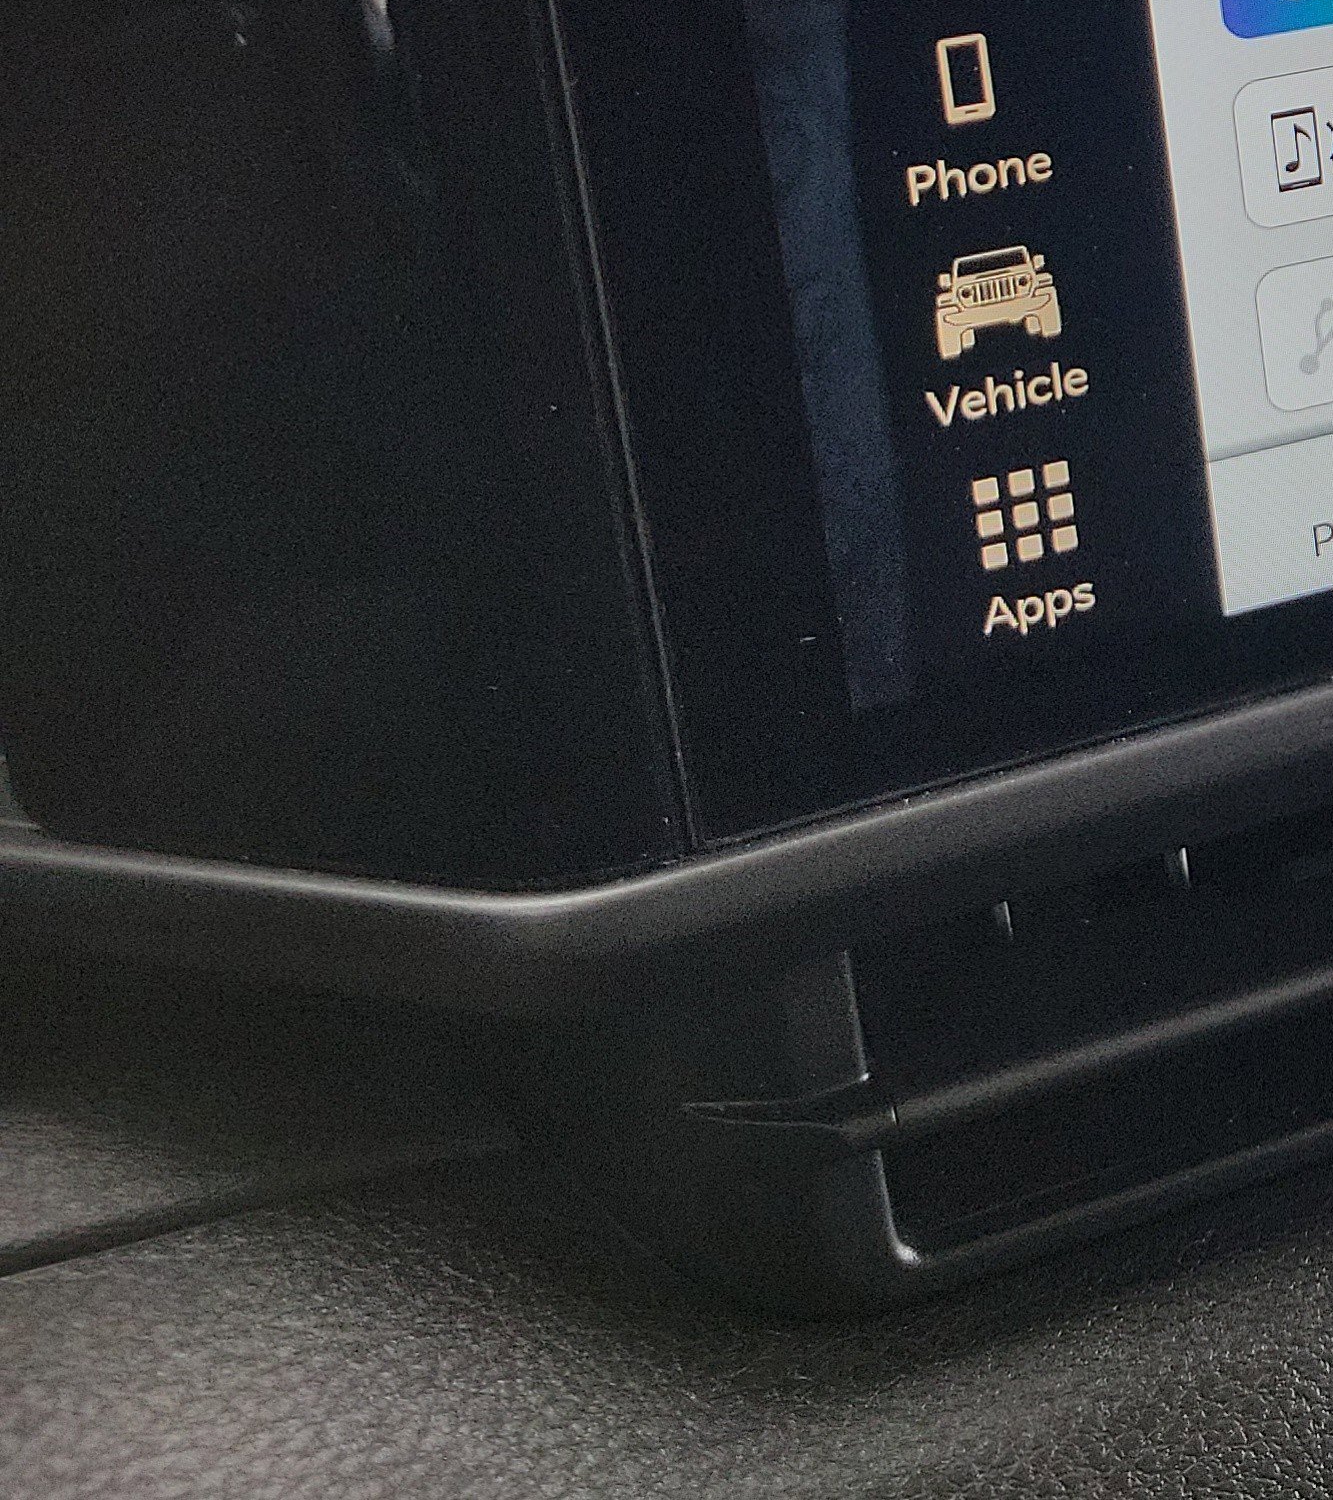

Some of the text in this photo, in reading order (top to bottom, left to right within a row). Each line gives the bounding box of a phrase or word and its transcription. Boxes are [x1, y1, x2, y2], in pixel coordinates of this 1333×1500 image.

[907, 149, 1053, 205] Phone
[926, 361, 1090, 428] Vehicle
[983, 577, 1096, 635] Apps
